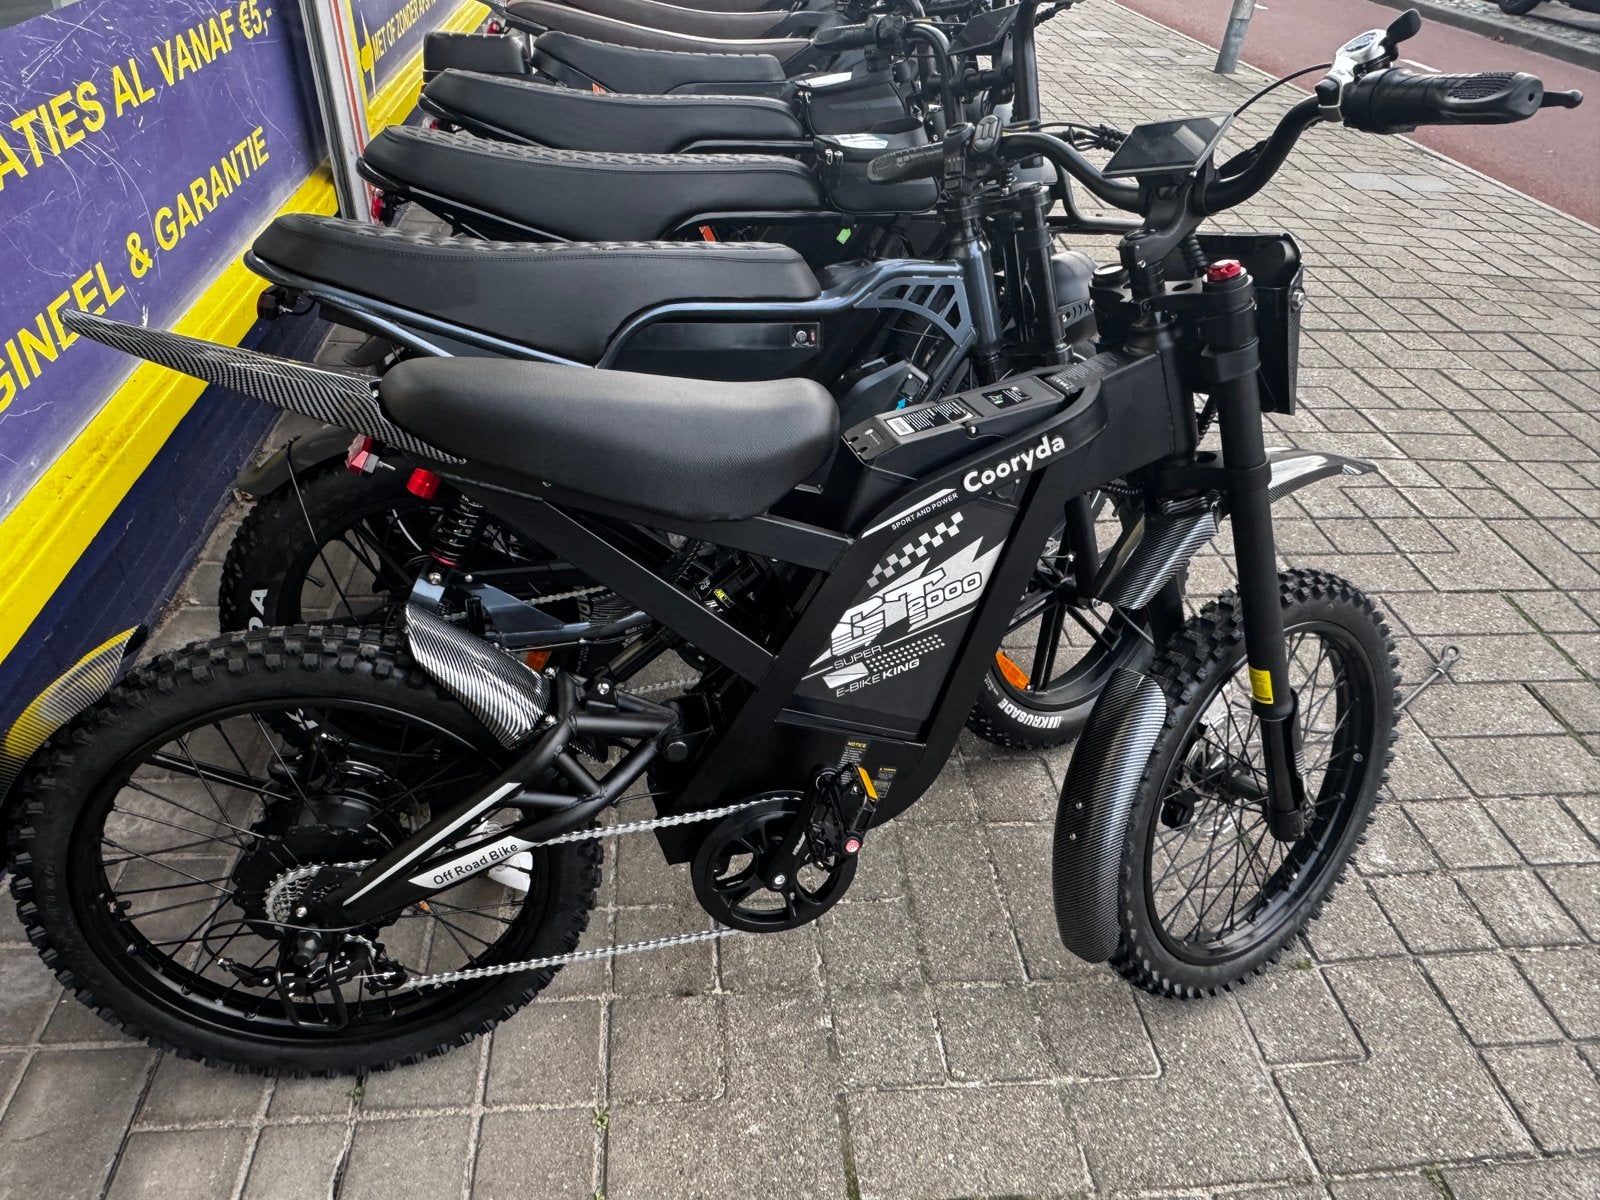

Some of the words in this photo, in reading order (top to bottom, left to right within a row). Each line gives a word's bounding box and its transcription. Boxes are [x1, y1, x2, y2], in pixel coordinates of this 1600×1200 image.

[111, 58, 155, 117] AL
[151, 10, 235, 87] VANAF
[239, 1, 273, 40] €5,-
[126, 232, 153, 278] &
[154, 127, 269, 252] GARANTIE
[963, 435, 1065, 492] Cooryda
[891, 513, 915, 531] SPORT
[916, 506, 932, 519] AND
[932, 493, 959, 510] POWER
[908, 572, 982, 614] 2000
[833, 645, 882, 669] SUPER
[836, 674, 881, 697] E-BIKE
[883, 658, 920, 679] KING
[433, 869, 453, 885] Off
[454, 855, 488, 877] Road
[488, 843, 518, 861] Bike
